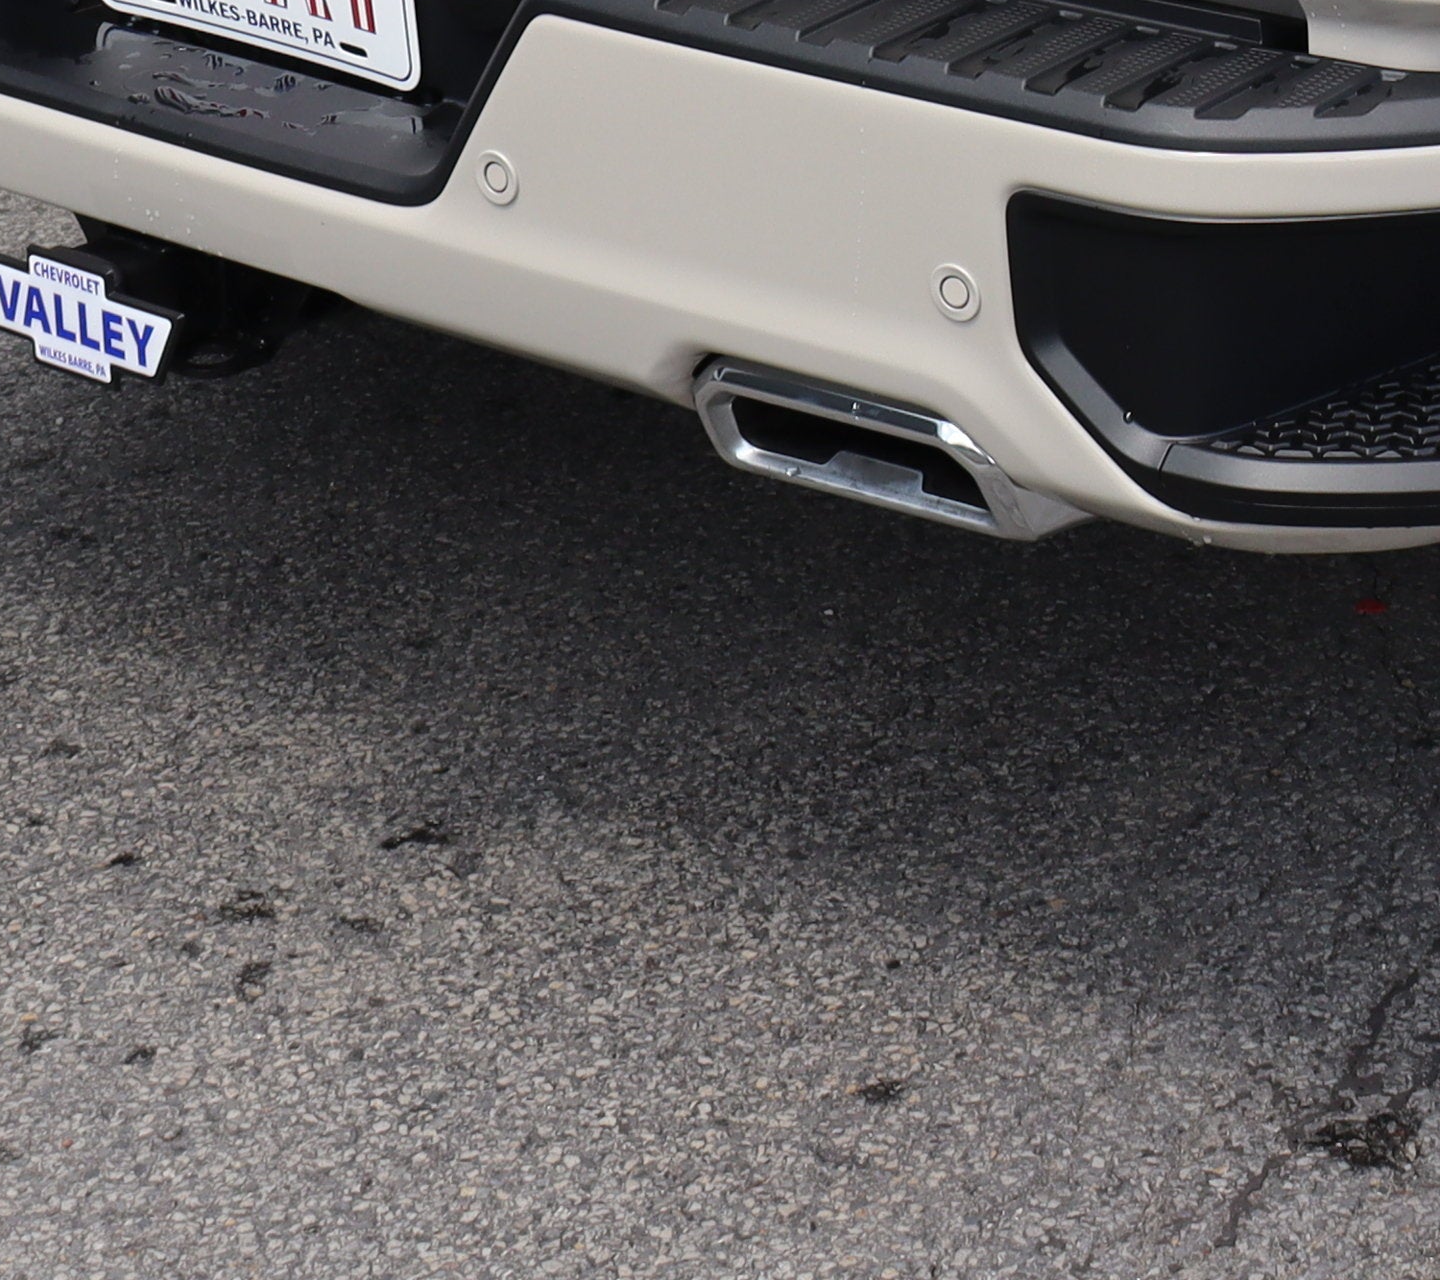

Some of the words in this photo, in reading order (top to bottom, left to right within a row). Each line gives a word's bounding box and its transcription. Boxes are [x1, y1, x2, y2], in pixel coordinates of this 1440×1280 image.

[312, 30, 337, 49] PA
[32, 261, 100, 296] CHEVROLET
[38, 344, 68, 363] WILKES
[95, 363, 107, 378] PA
